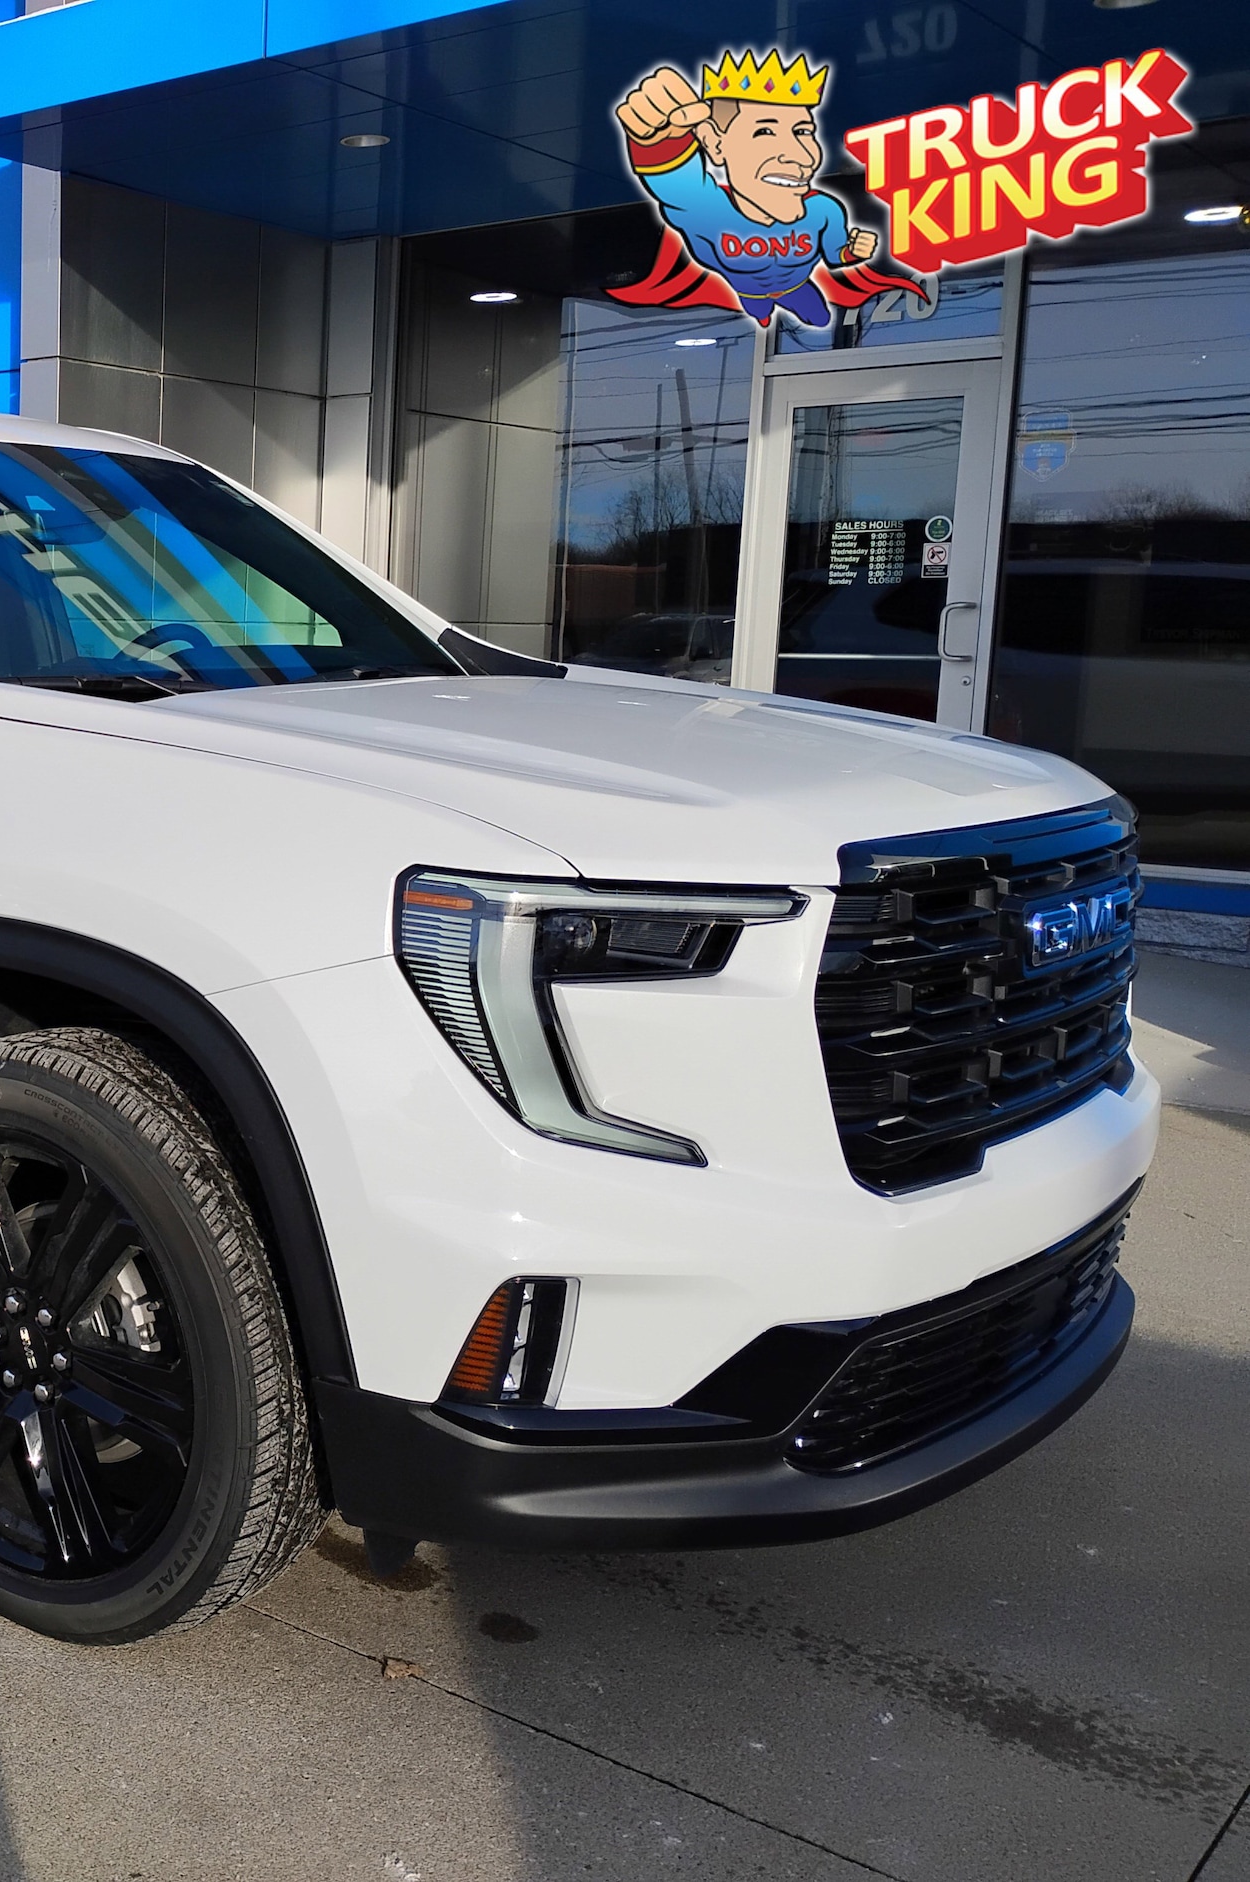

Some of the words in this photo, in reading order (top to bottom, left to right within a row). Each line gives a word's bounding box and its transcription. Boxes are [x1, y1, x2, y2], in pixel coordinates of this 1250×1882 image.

[835, 521, 867, 530] SALES
[869, 520, 904, 529] HOURS
[831, 533, 858, 541] Monday
[870, 532, 906, 540] 9:00-7:00
[829, 563, 850, 571] Friday
[1031, 886, 1131, 967] GMC
